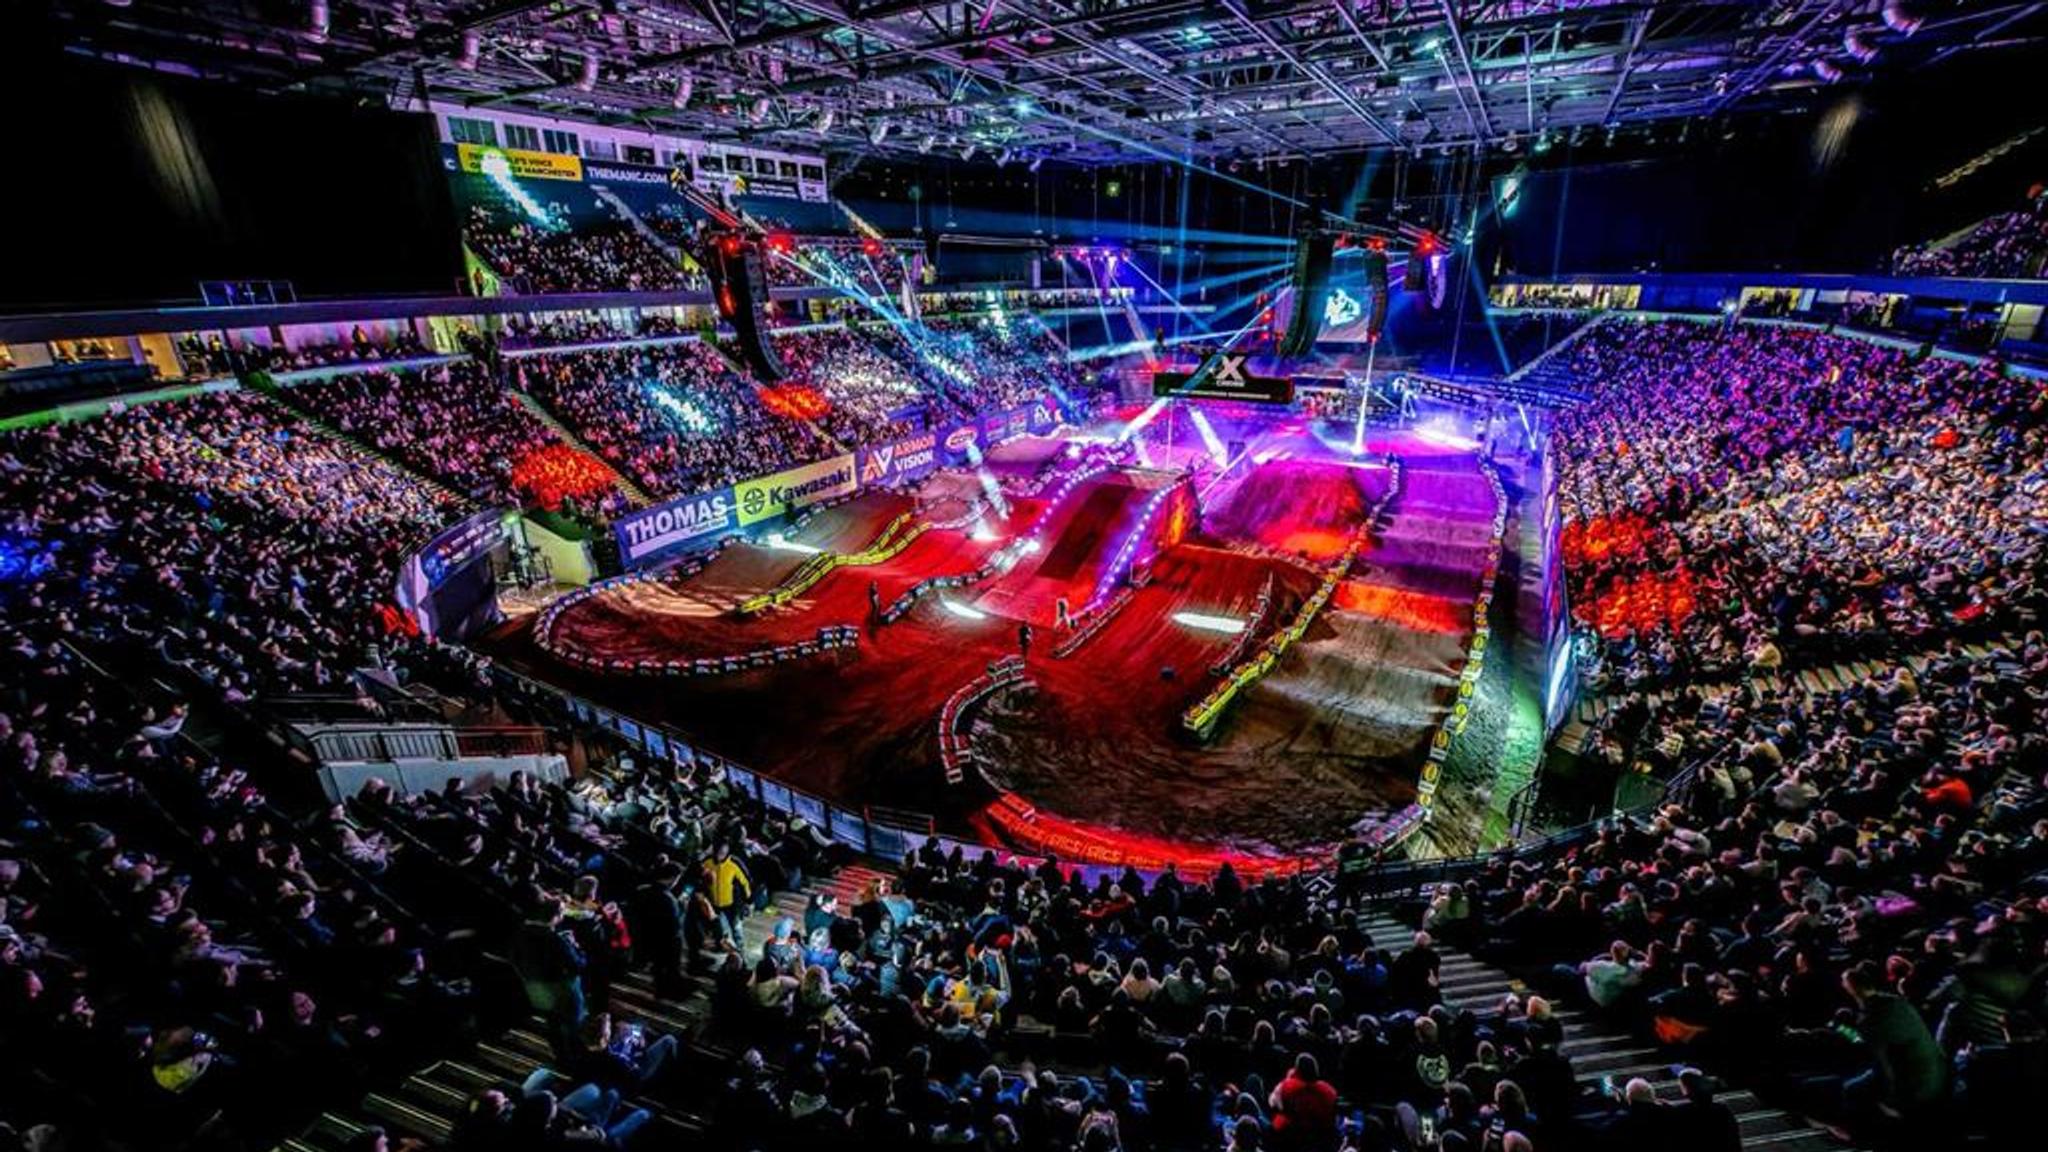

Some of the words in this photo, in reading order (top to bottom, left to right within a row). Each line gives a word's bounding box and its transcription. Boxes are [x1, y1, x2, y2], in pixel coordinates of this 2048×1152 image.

[524, 167, 576, 177] MANCHESTER
[587, 165, 668, 184] THEMANC.COM
[894, 449, 934, 472] VISION
[768, 465, 852, 505] Kawasaki
[625, 495, 728, 545] THOMAS
